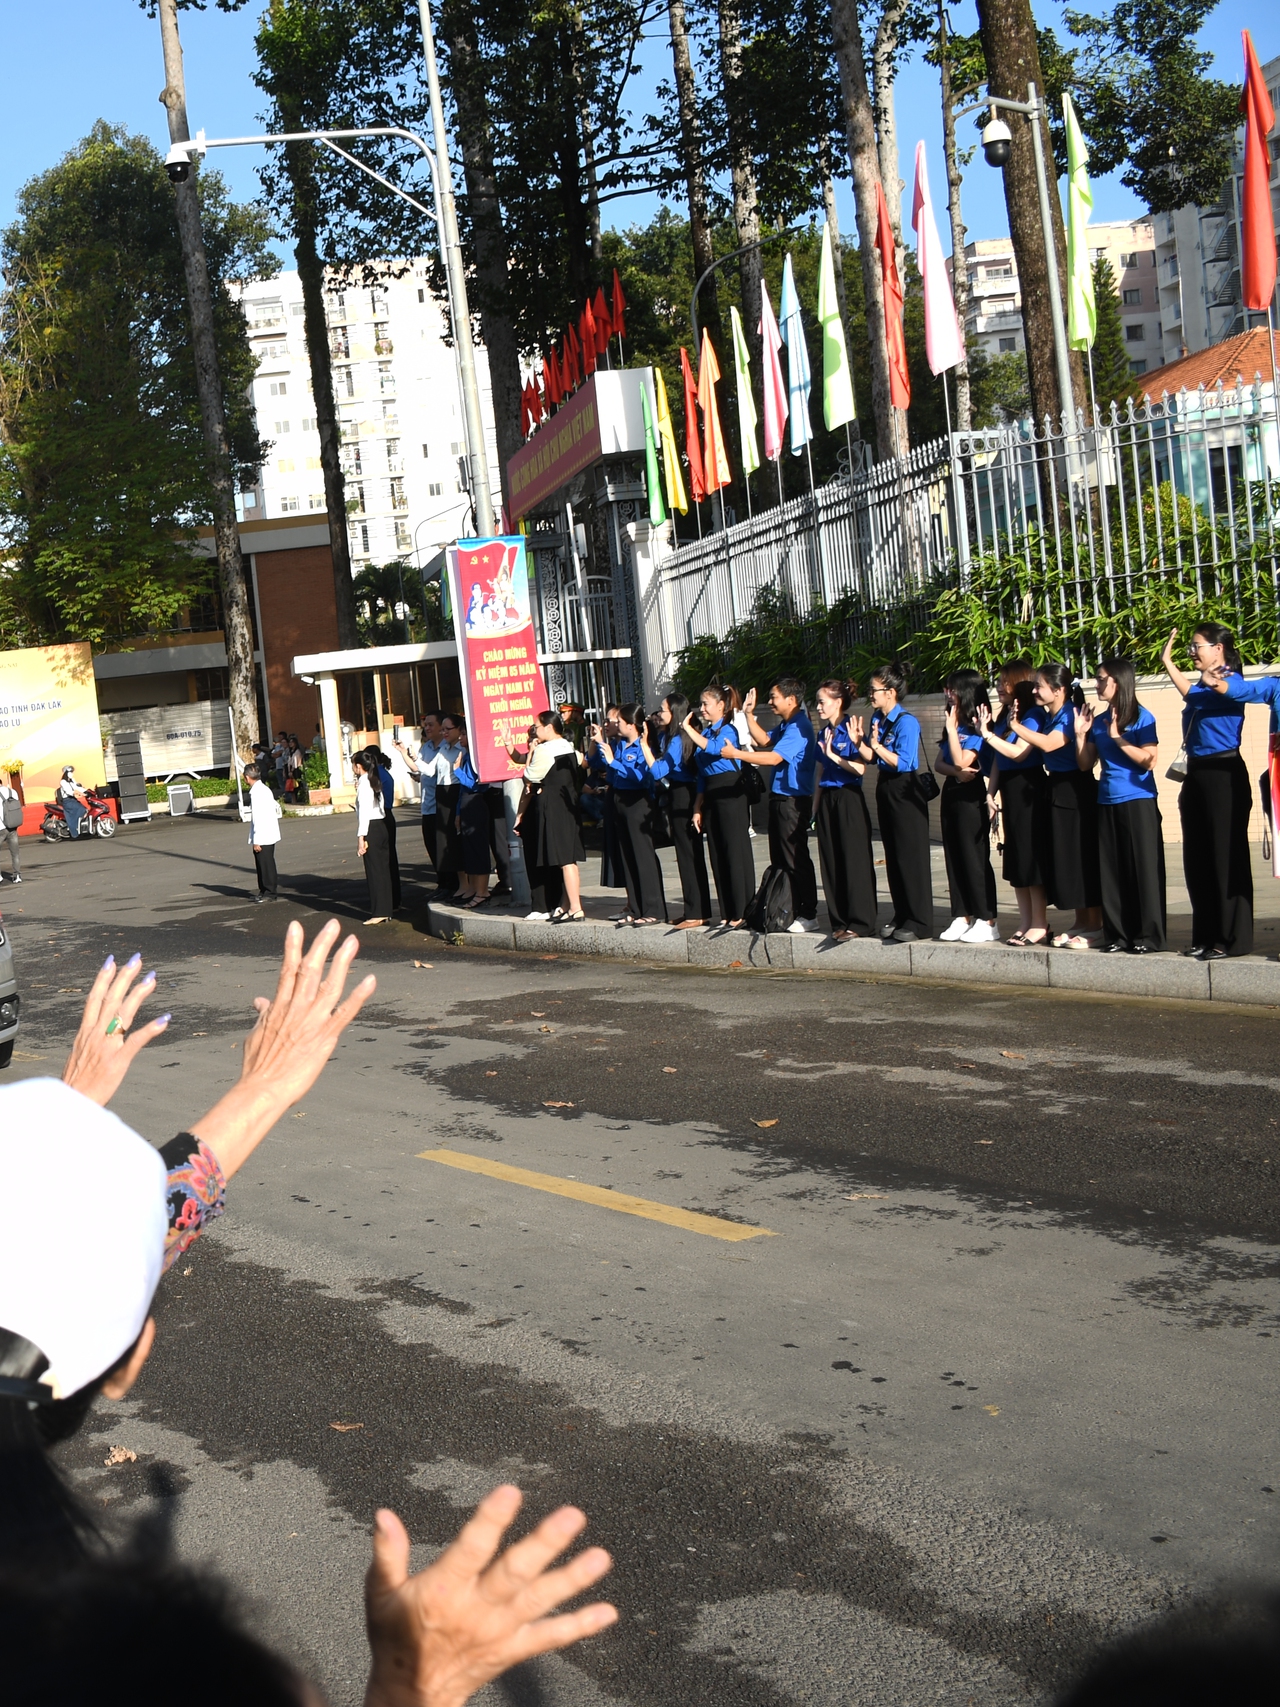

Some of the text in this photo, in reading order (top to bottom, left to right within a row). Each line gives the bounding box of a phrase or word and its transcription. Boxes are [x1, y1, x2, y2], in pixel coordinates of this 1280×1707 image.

[582, 402, 595, 435] NAM
[483, 646, 527, 663] CHÀO MỪNG
[488, 665, 508, 681] NIỆM
[509, 665, 518, 677] 85
[518, 662, 537, 676] NĂM
[483, 682, 504, 697] NGÀY
[505, 681, 523, 695] NAM
[489, 696, 533, 714] KHỞI NGHĨA
